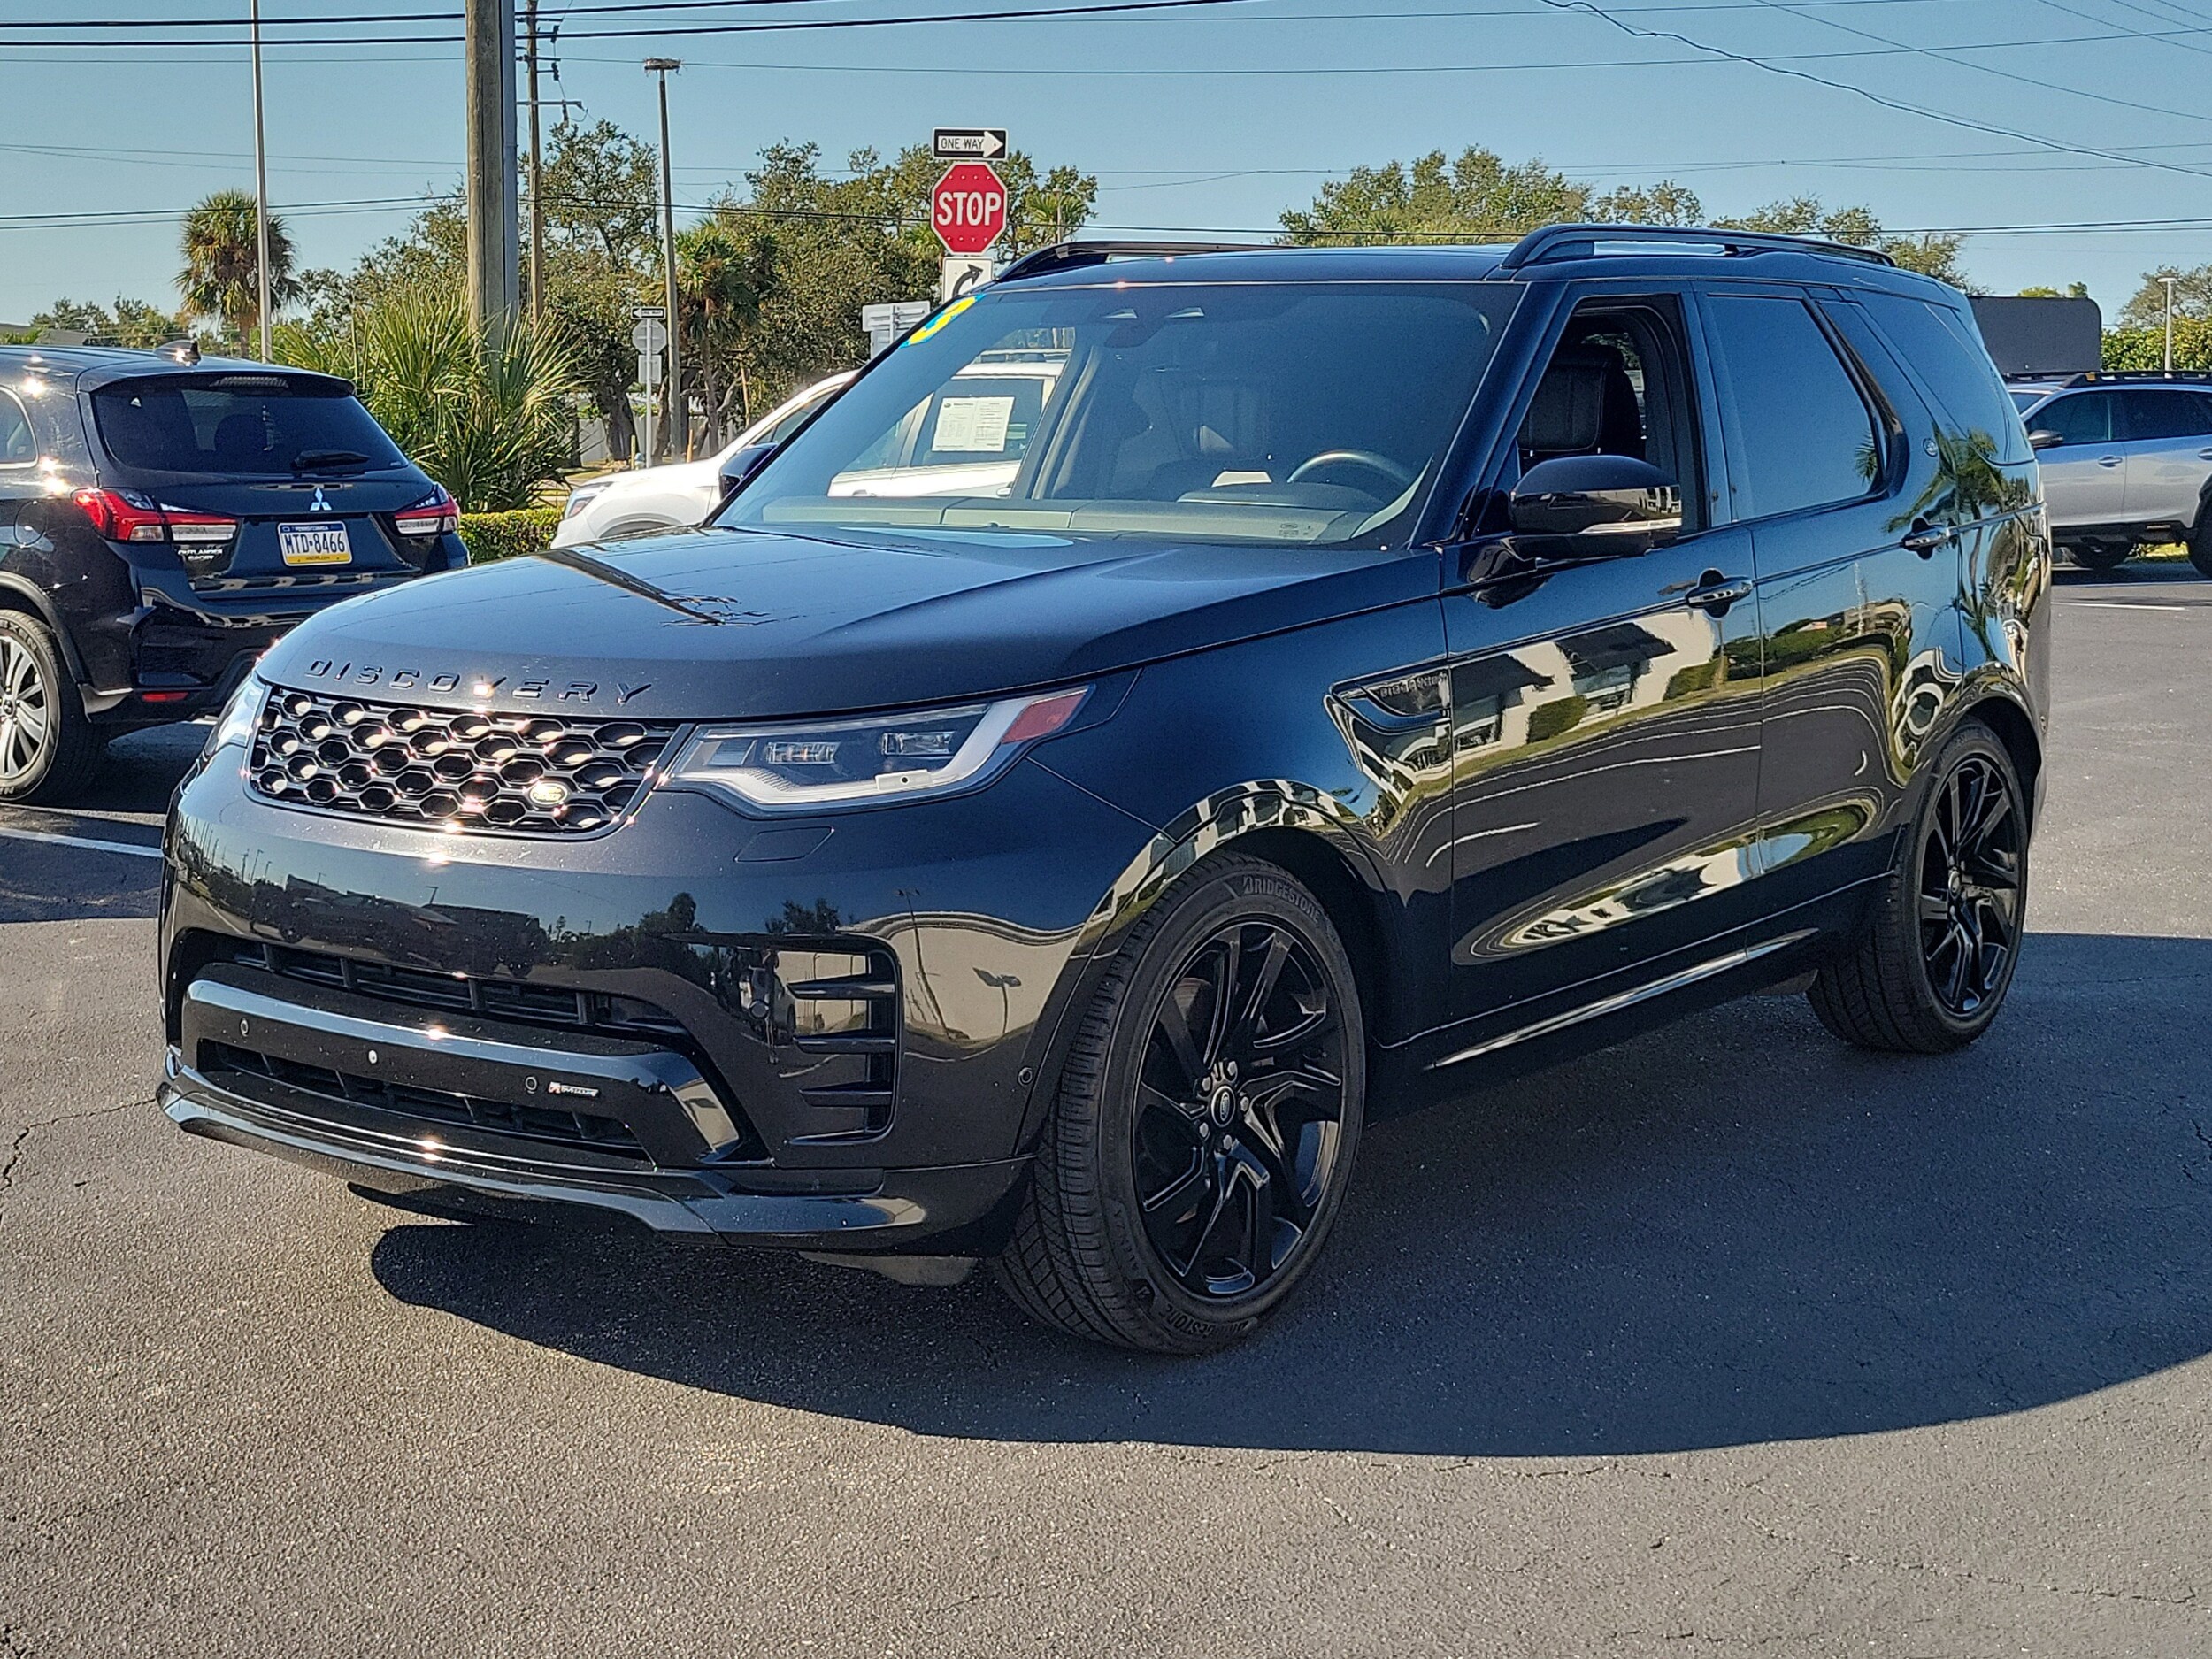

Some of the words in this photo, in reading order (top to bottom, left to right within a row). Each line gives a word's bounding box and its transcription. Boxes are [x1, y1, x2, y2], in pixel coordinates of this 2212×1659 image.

[941, 137, 961, 150] ONE
[964, 138, 985, 150] WAY
[936, 191, 1002, 227] STOP
[305, 659, 652, 704] DISCOVERY
[1243, 875, 1321, 924] BRIDGESTONE
